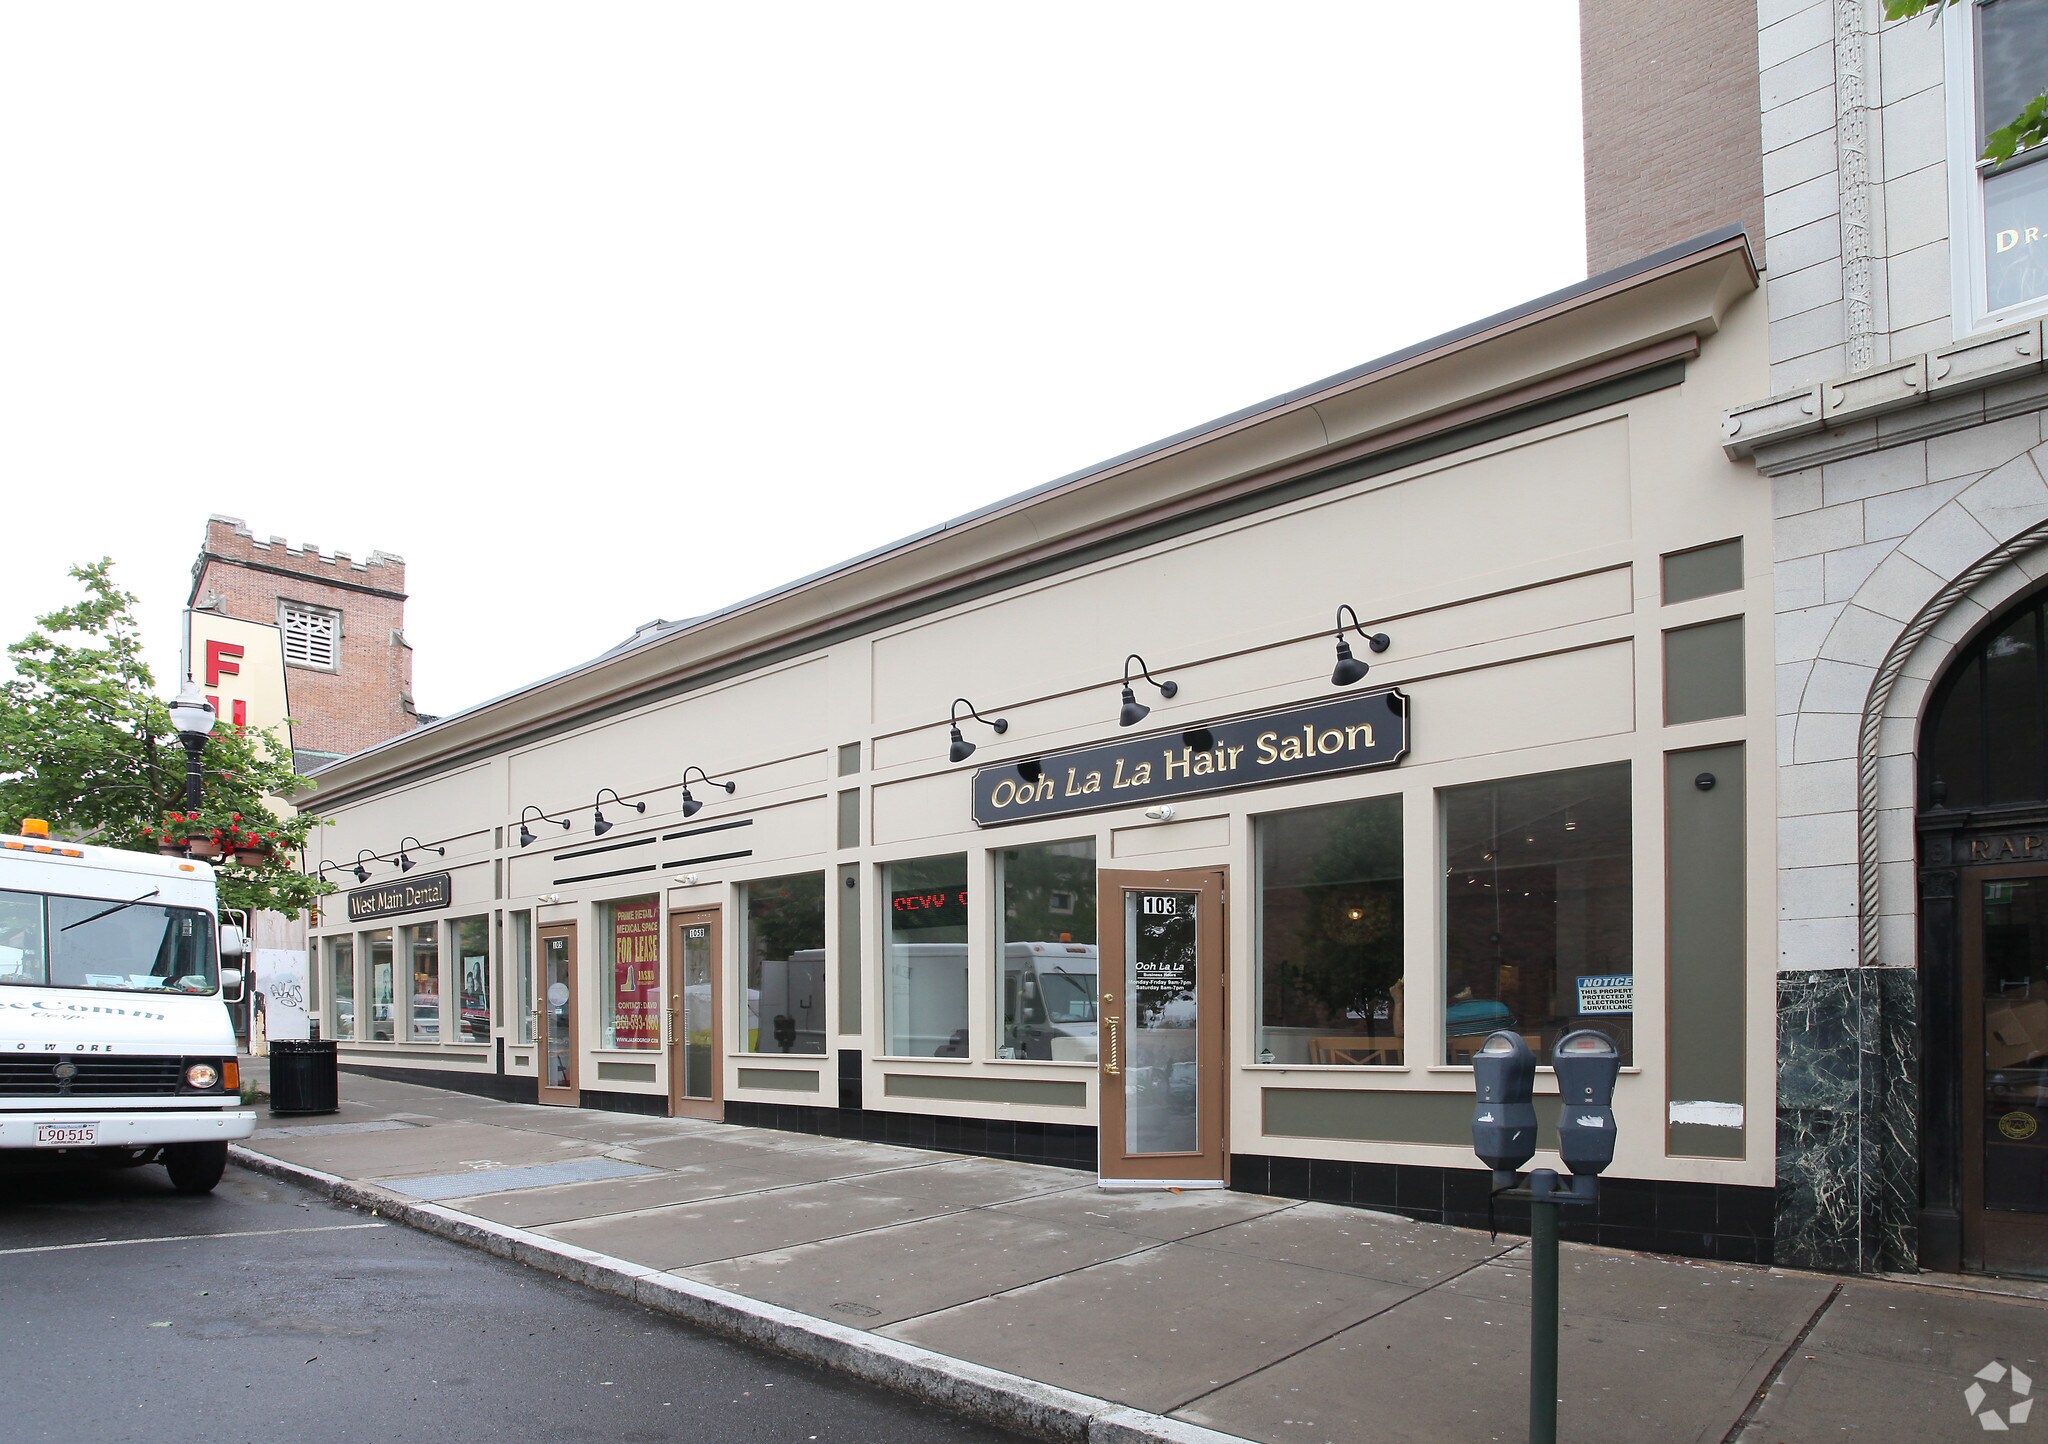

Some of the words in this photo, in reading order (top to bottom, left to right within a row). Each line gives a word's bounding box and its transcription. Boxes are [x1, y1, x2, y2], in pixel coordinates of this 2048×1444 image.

[991, 772, 1055, 808] Ooh
[1064, 767, 1102, 797] La
[1112, 758, 1152, 789] La
[1163, 739, 1244, 781] Hair
[1256, 722, 1376, 765] Salon
[352, 895, 376, 915] West
[378, 890, 403, 911] Main
[405, 881, 443, 906] Dental
[1145, 897, 1175, 913] 103
[617, 910, 635, 921] PRIME
[616, 923, 641, 934] MEDICAL
[641, 921, 658, 932] SPACE
[616, 937, 632, 963] FOR
[634, 935, 658, 962] LEASE
[1135, 961, 1157, 970] Ooh
[1159, 962, 1171, 970] La
[1173, 962, 1185, 970] La
[1583, 977, 1633, 987] NOTICE
